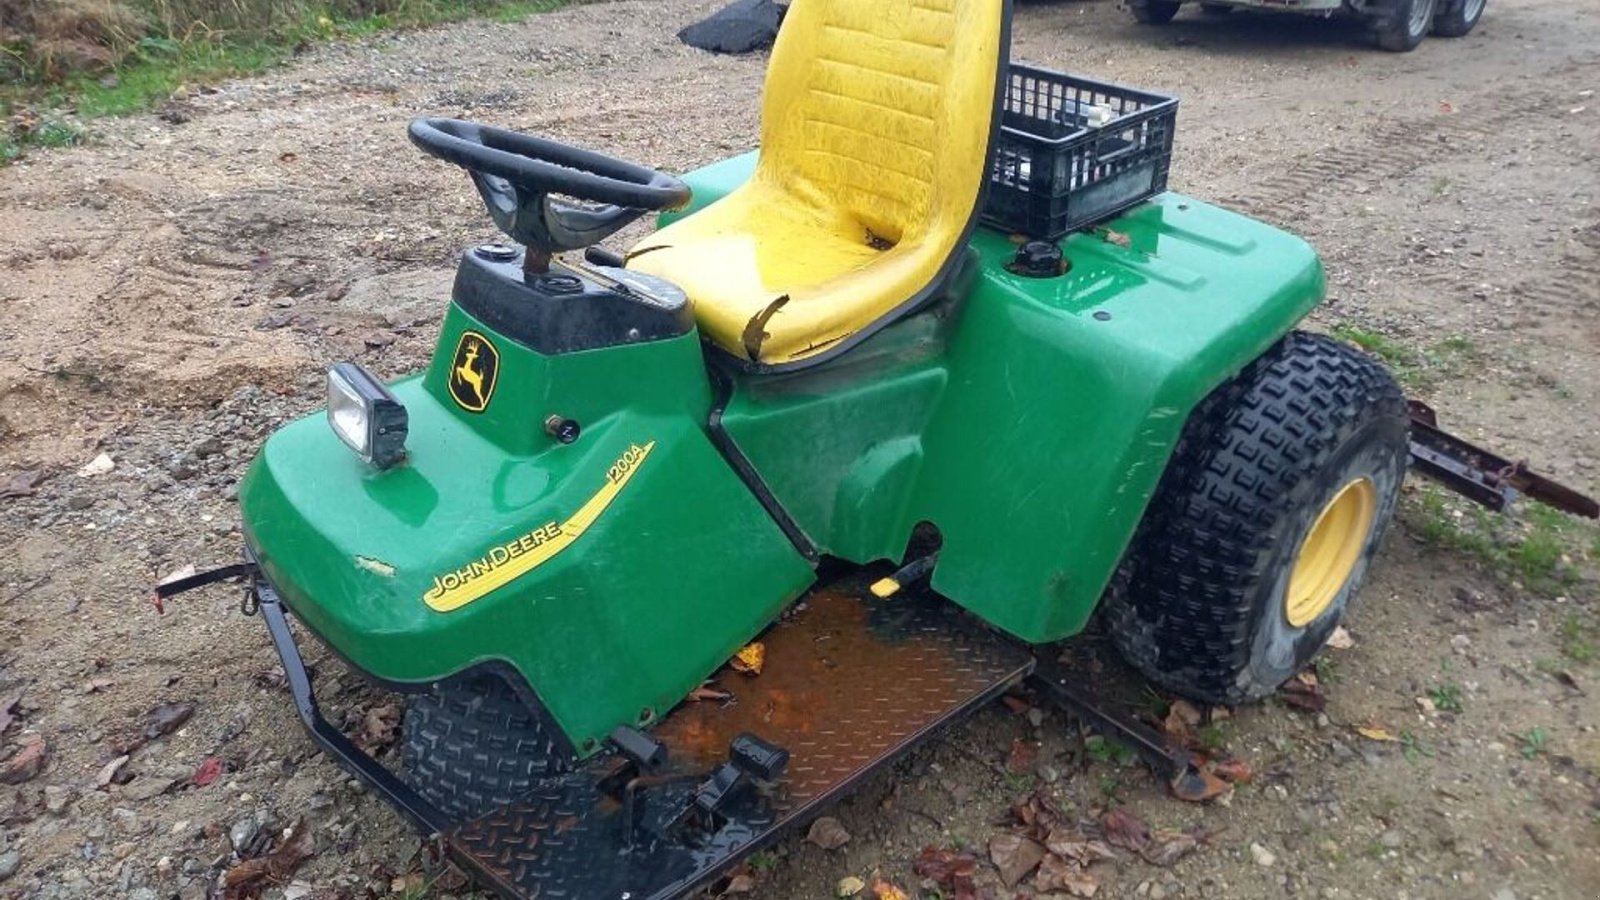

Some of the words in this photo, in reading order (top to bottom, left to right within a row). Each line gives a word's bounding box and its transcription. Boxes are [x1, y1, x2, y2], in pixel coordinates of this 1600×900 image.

[606, 444, 645, 483] 1200A
[432, 557, 493, 598] JOHN
[489, 521, 562, 567] DEERE
